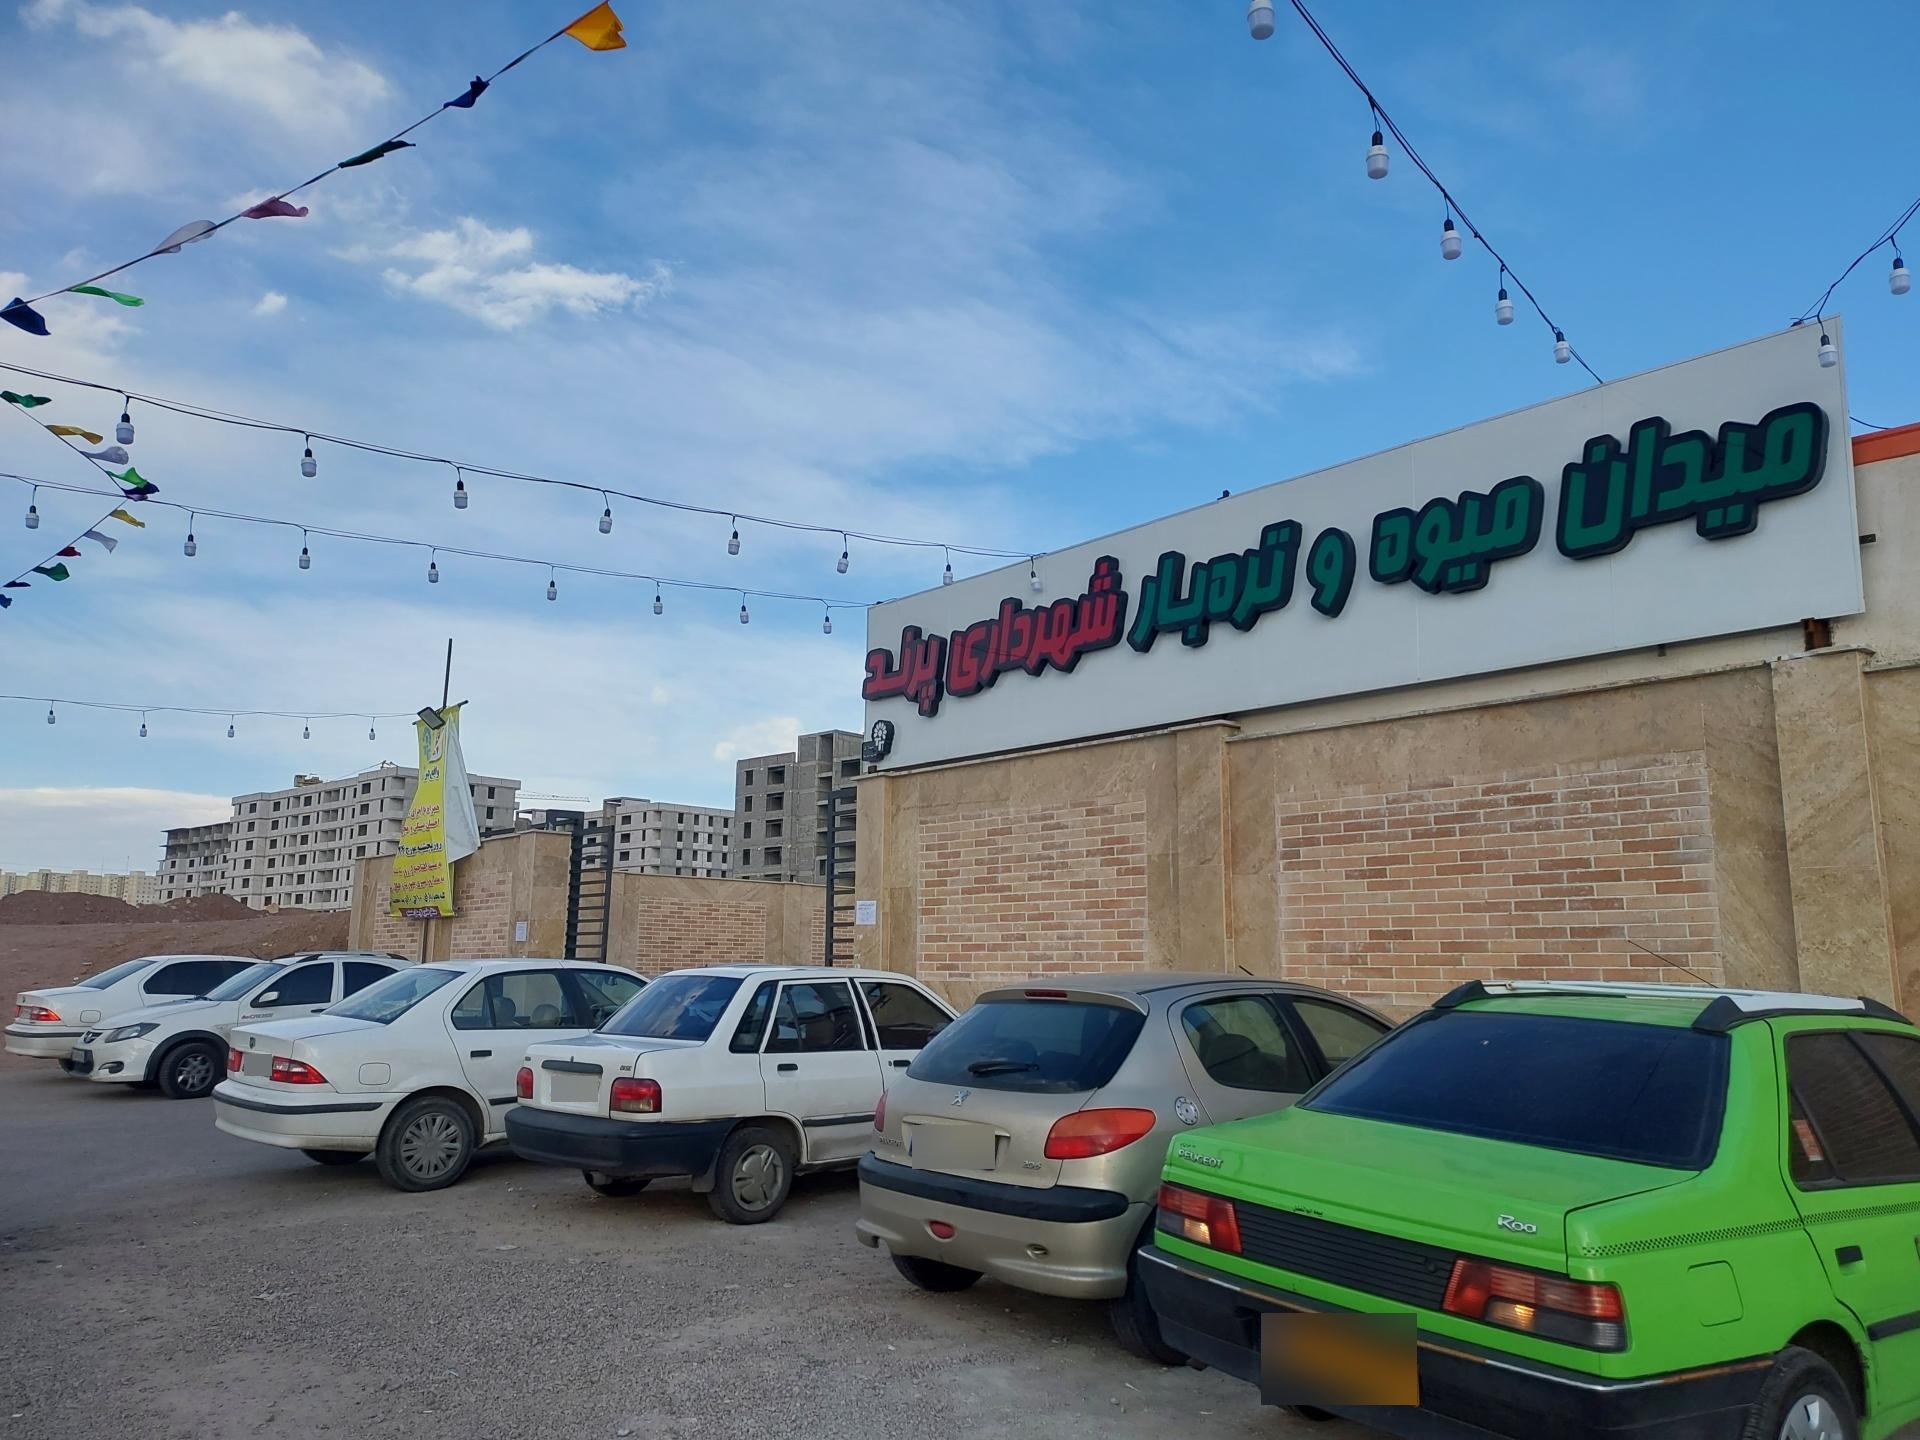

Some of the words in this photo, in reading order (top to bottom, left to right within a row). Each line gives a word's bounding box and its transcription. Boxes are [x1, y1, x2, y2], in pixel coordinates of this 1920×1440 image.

[1556, 401, 1830, 560] میدان
[1306, 527, 1357, 618] و
[1369, 475, 1545, 594] میوه
[862, 625, 948, 717] پرند
[946, 555, 1128, 697] شهرداری
[1178, 1148, 1224, 1169] PEUGEOT
[1497, 1214, 1537, 1234] Roa
